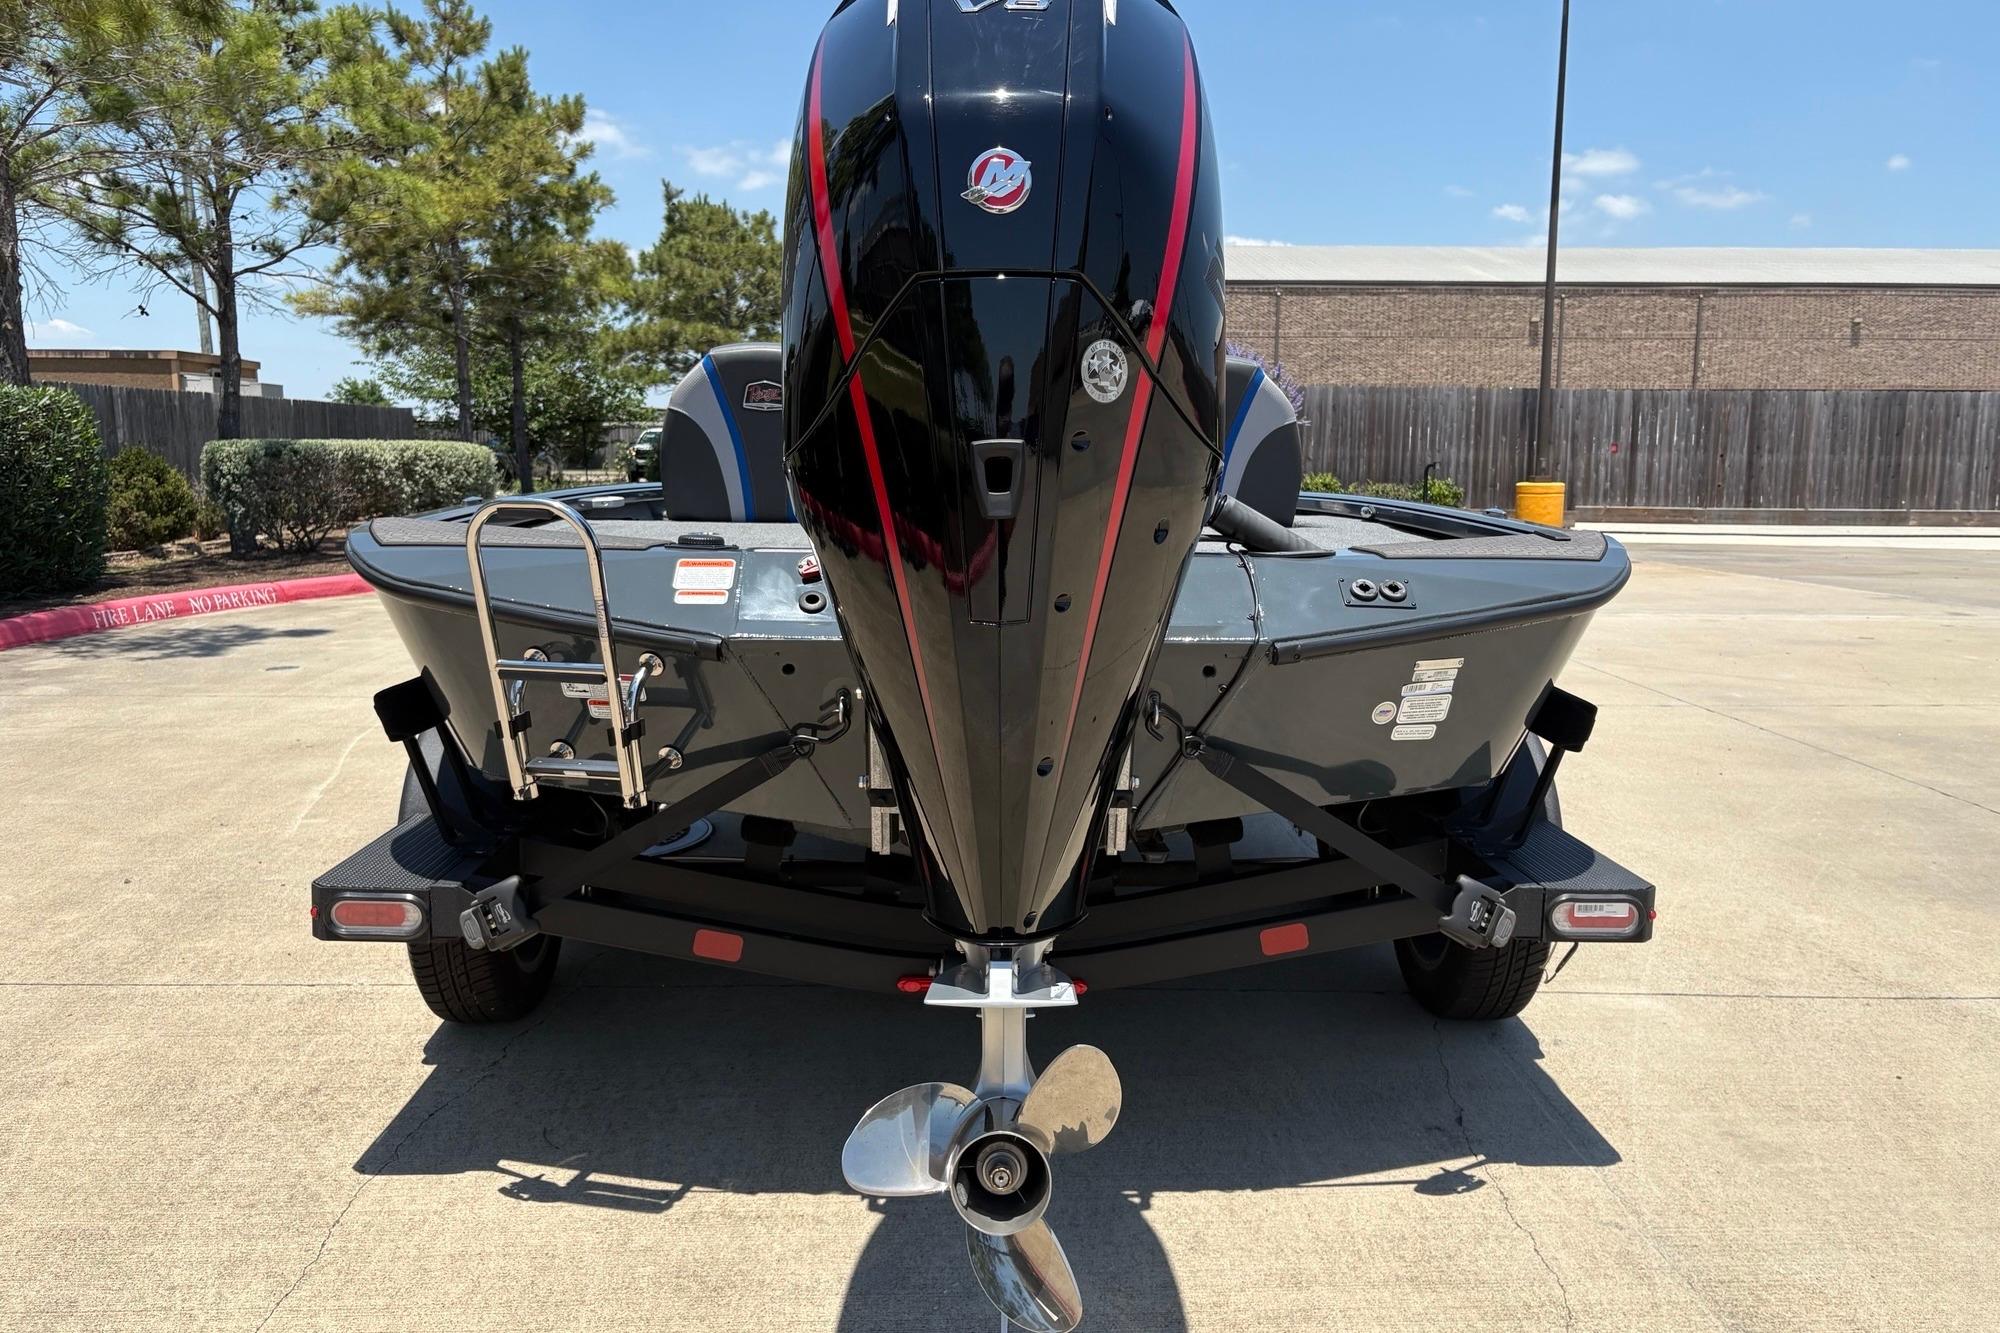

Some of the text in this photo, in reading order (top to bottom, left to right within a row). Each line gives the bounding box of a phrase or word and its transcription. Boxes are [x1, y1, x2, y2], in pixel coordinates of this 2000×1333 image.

[92, 587, 277, 628] FIRE LANE NO PARKING
